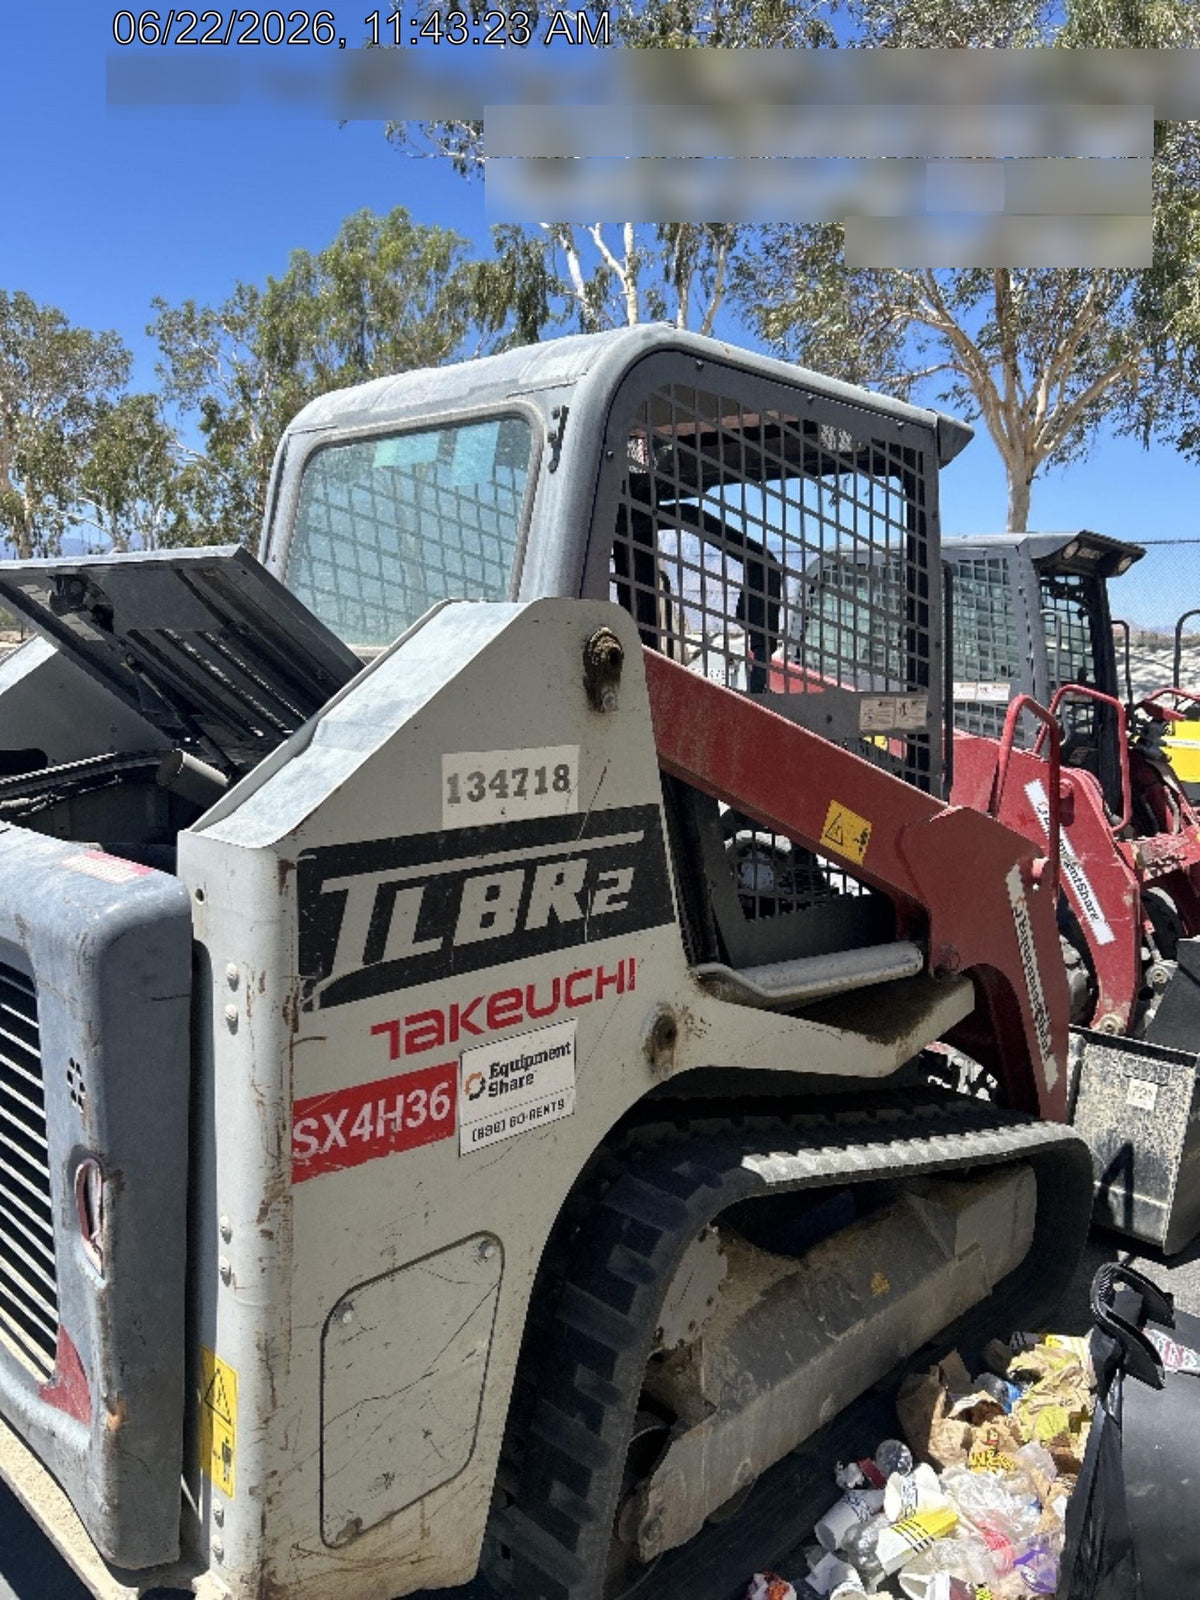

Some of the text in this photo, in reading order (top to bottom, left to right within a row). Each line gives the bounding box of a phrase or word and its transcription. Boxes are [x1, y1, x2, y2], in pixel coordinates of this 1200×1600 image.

[446, 763, 571, 805] 134718
[370, 957, 637, 1061] TAKEUCHI
[489, 1041, 572, 1080] Equipment
[488, 1073, 535, 1098] Share
[291, 1081, 452, 1160] SX4H36
